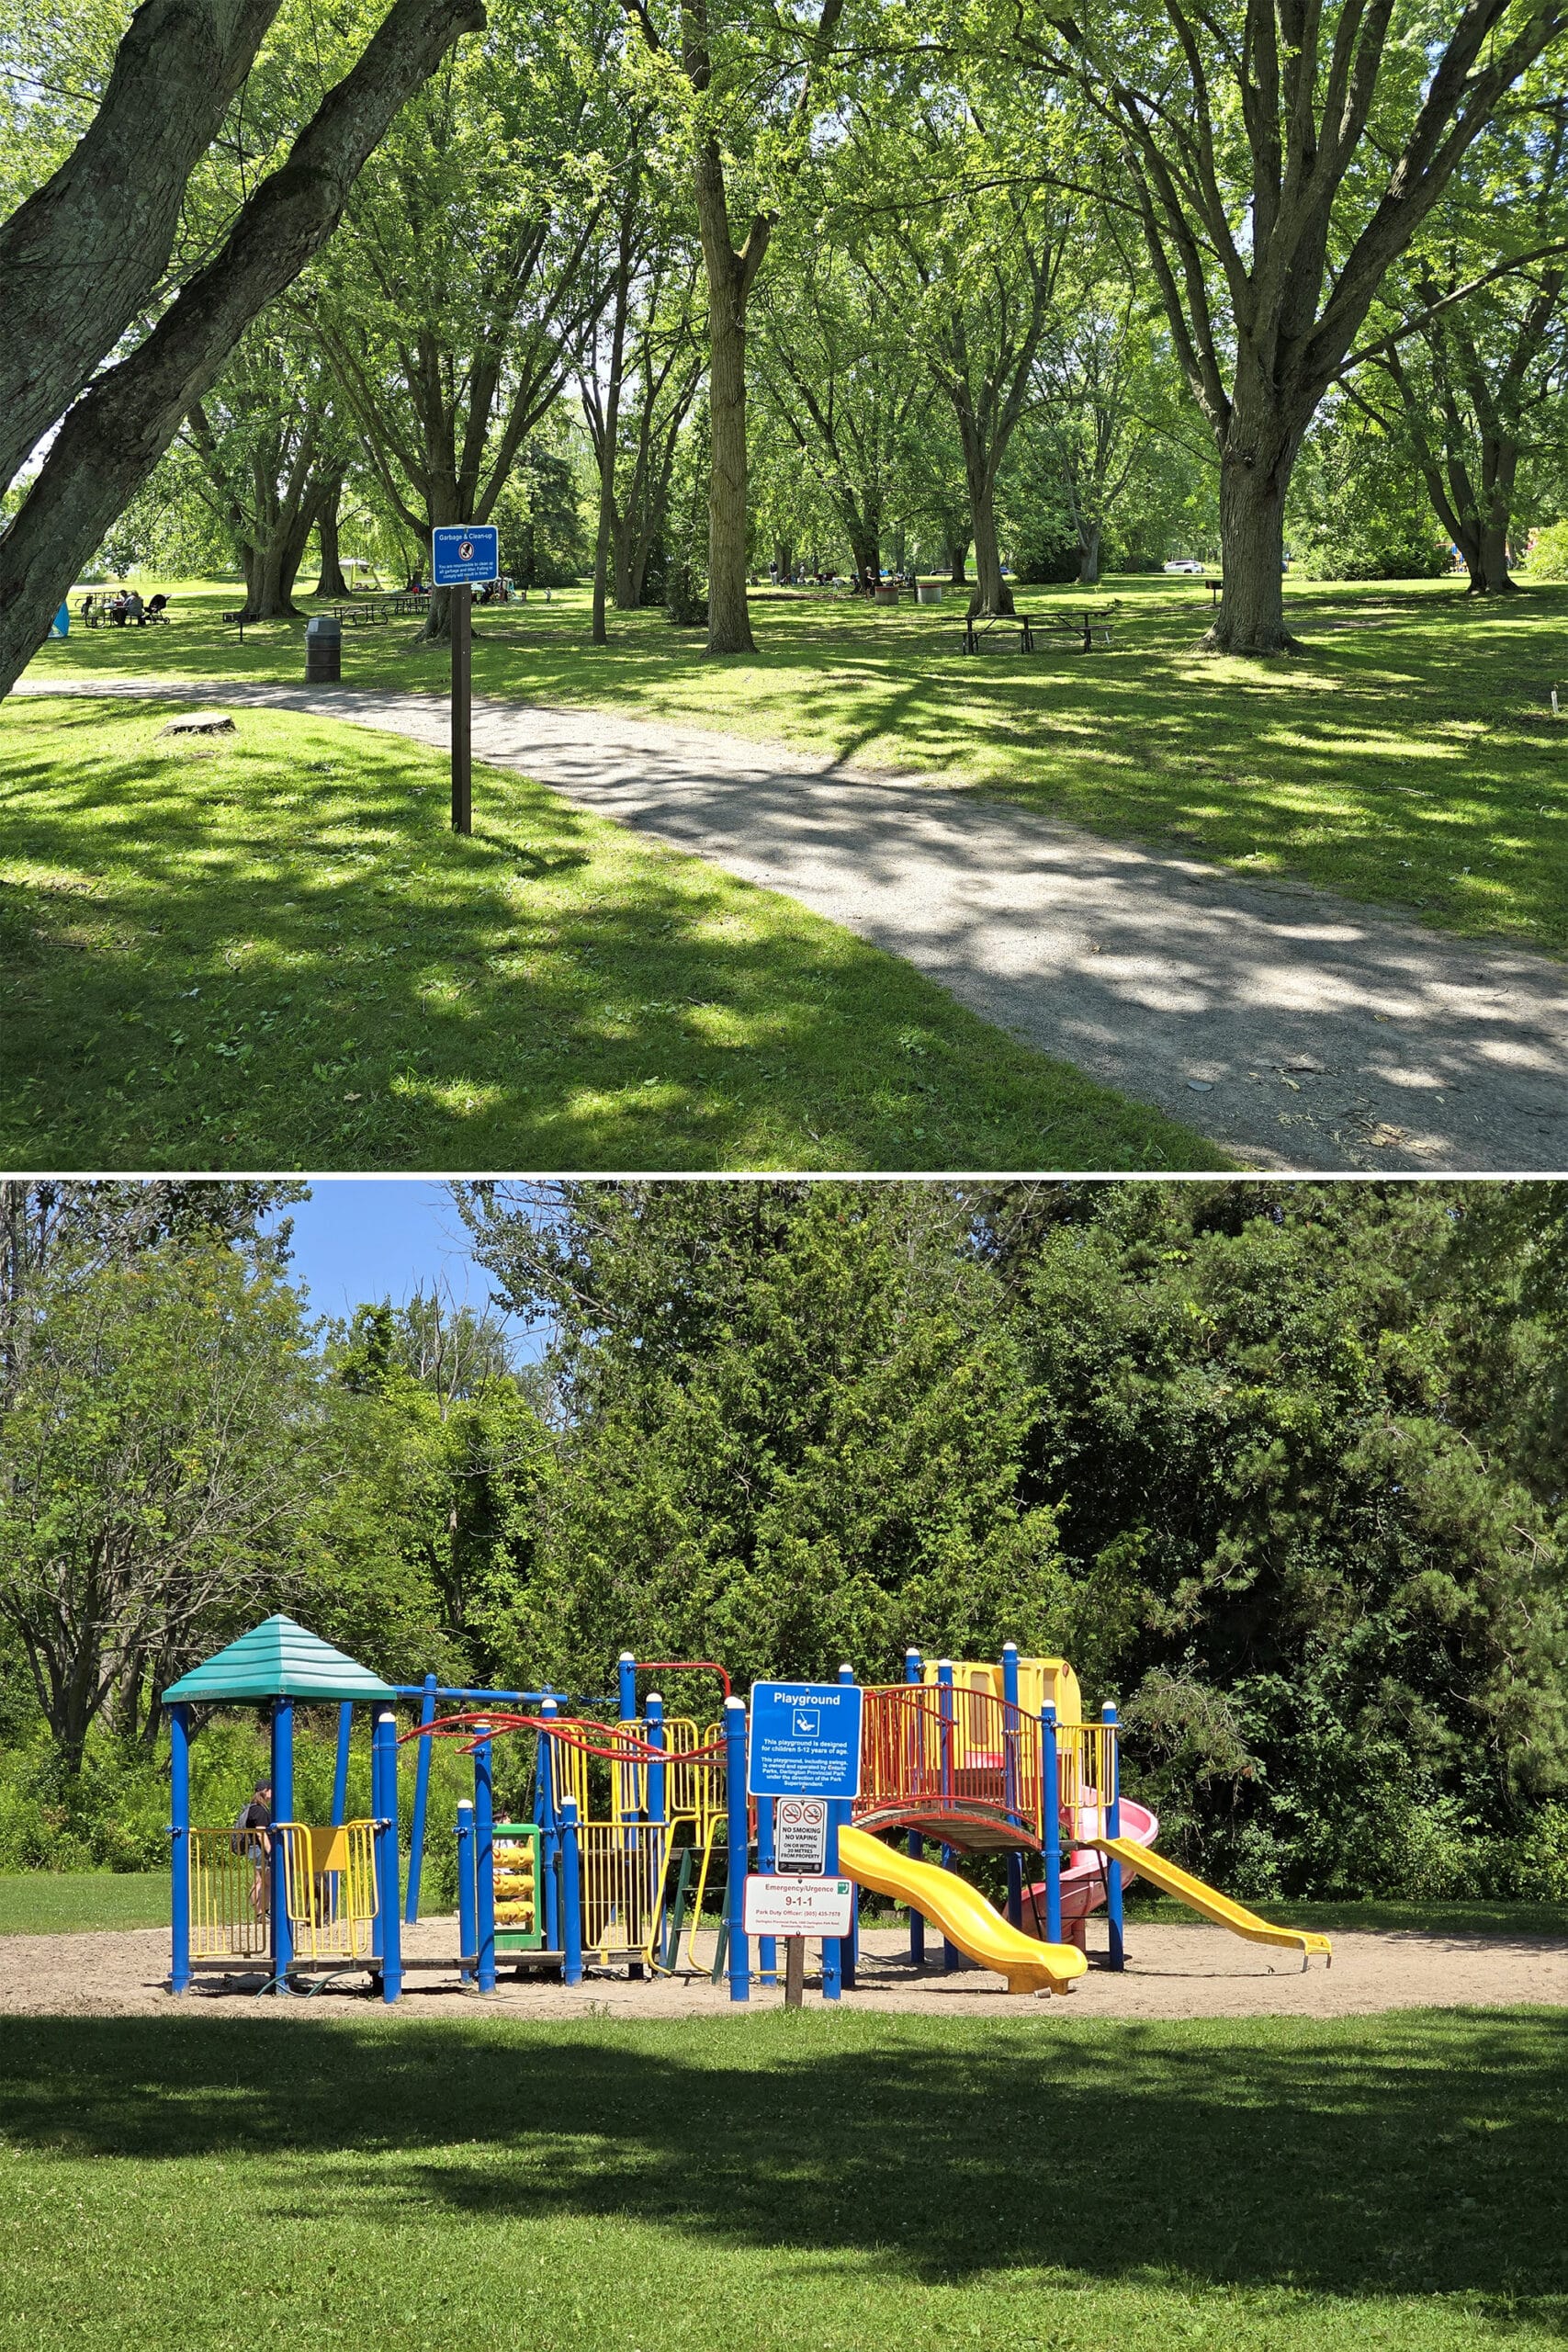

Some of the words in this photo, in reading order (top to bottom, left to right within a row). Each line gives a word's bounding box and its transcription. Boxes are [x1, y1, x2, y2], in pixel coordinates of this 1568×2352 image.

[774, 1692, 840, 1706] Playground
[766, 1884, 833, 1893] Emergency/Urgence
[786, 1896, 812, 1906] 9-1-1
